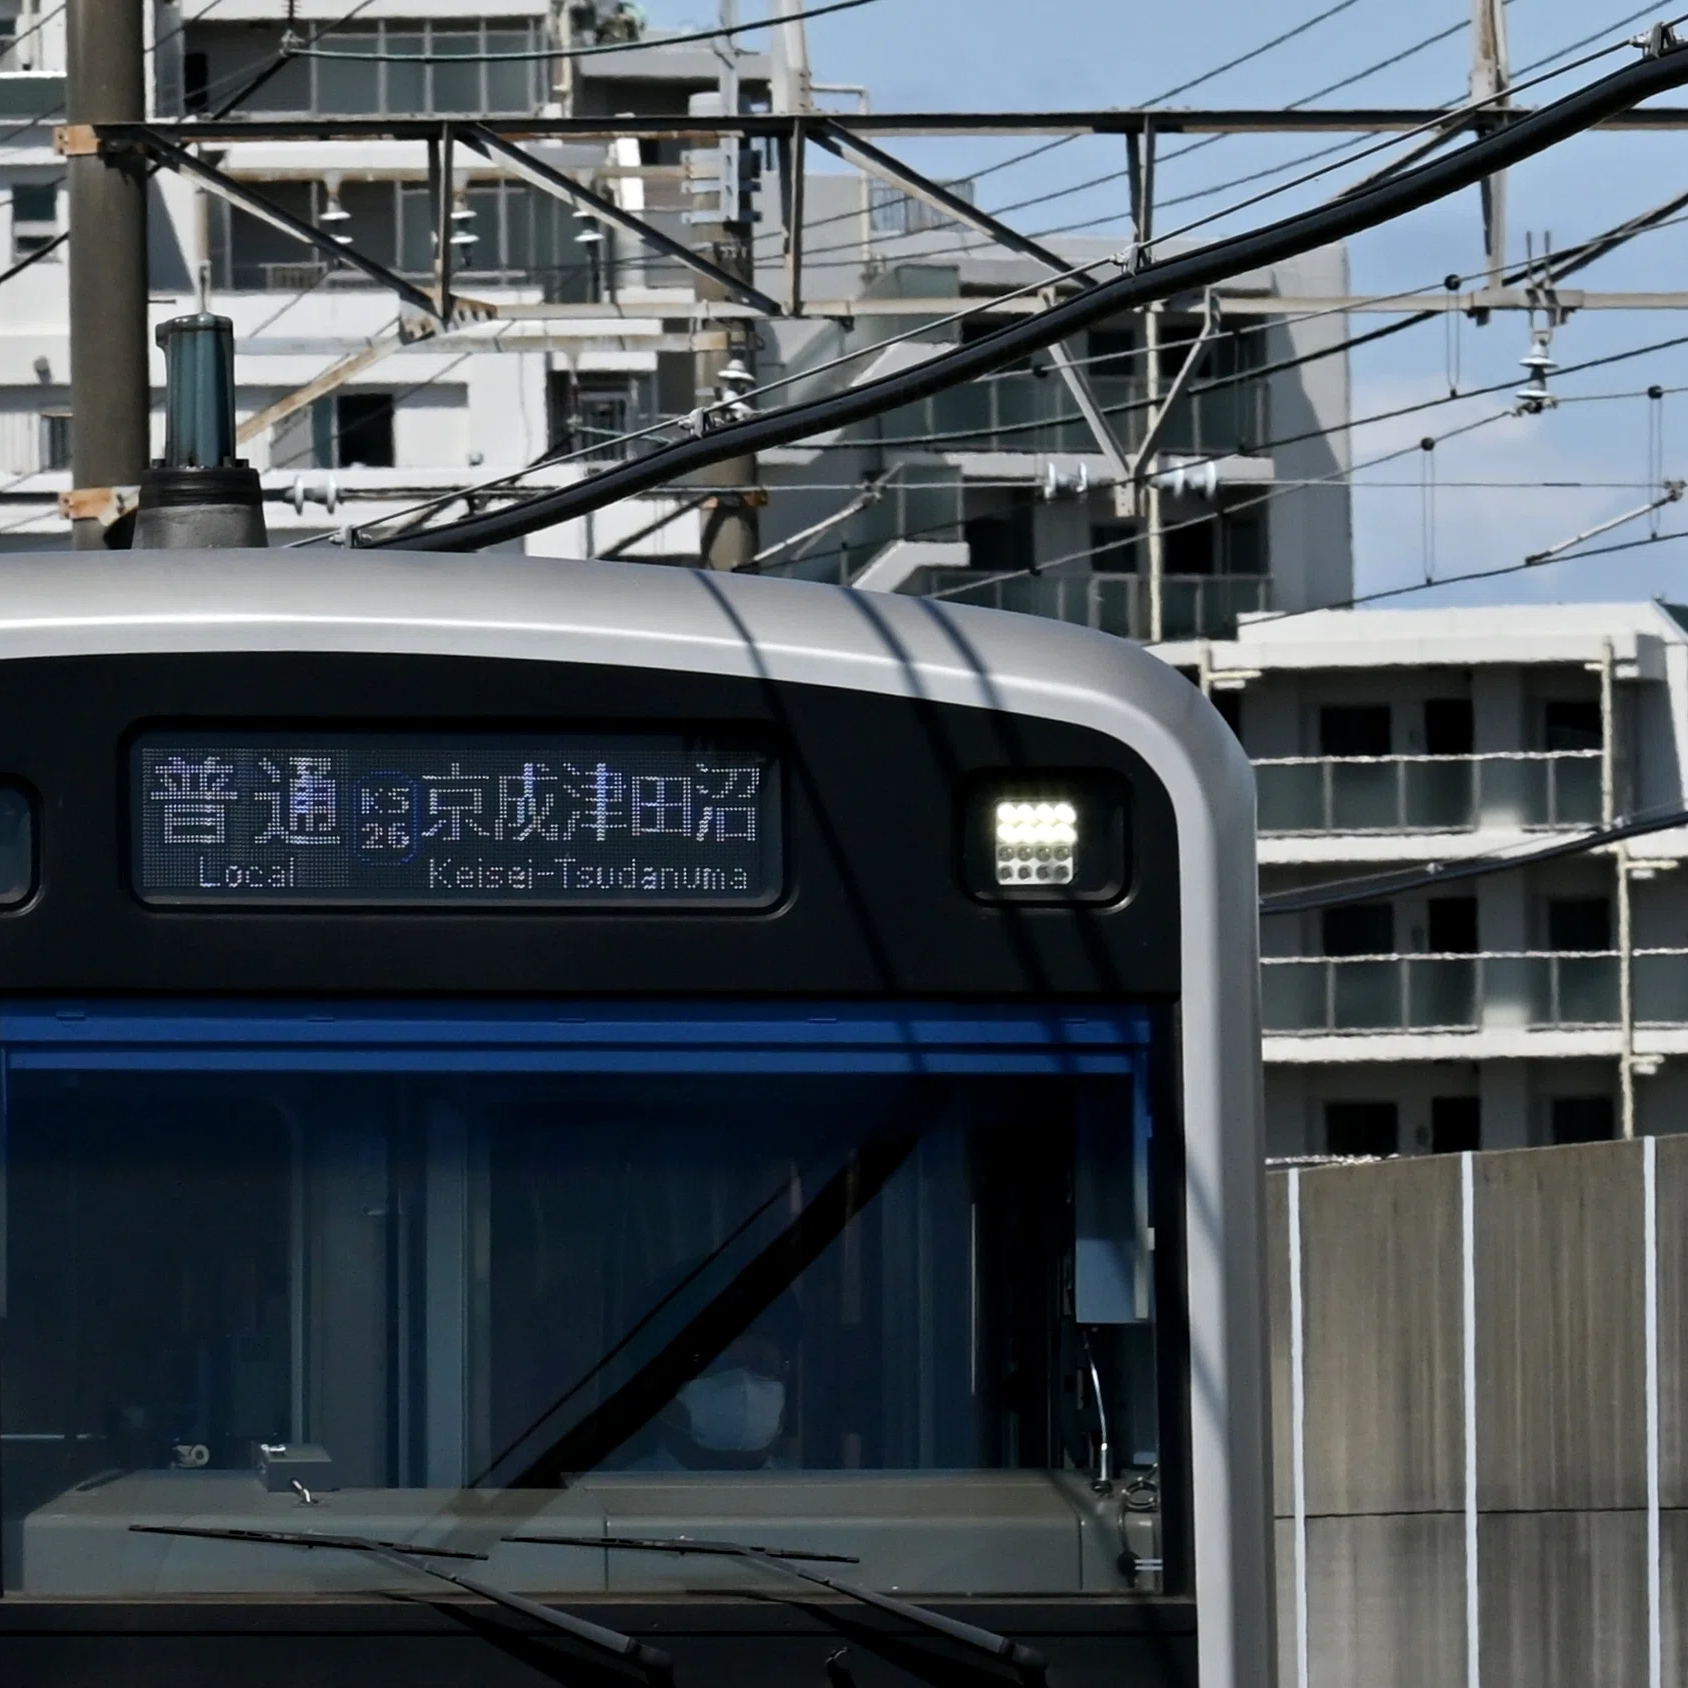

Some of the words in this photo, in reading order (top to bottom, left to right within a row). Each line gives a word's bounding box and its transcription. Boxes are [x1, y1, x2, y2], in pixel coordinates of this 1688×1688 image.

[149, 756, 342, 845] 普通
[361, 787, 411, 815] KS
[422, 761, 760, 843] 京成津田沼
[361, 822, 410, 849] 26
[200, 857, 296, 889] Local
[429, 858, 748, 890] Keisei-Tsudanuma
